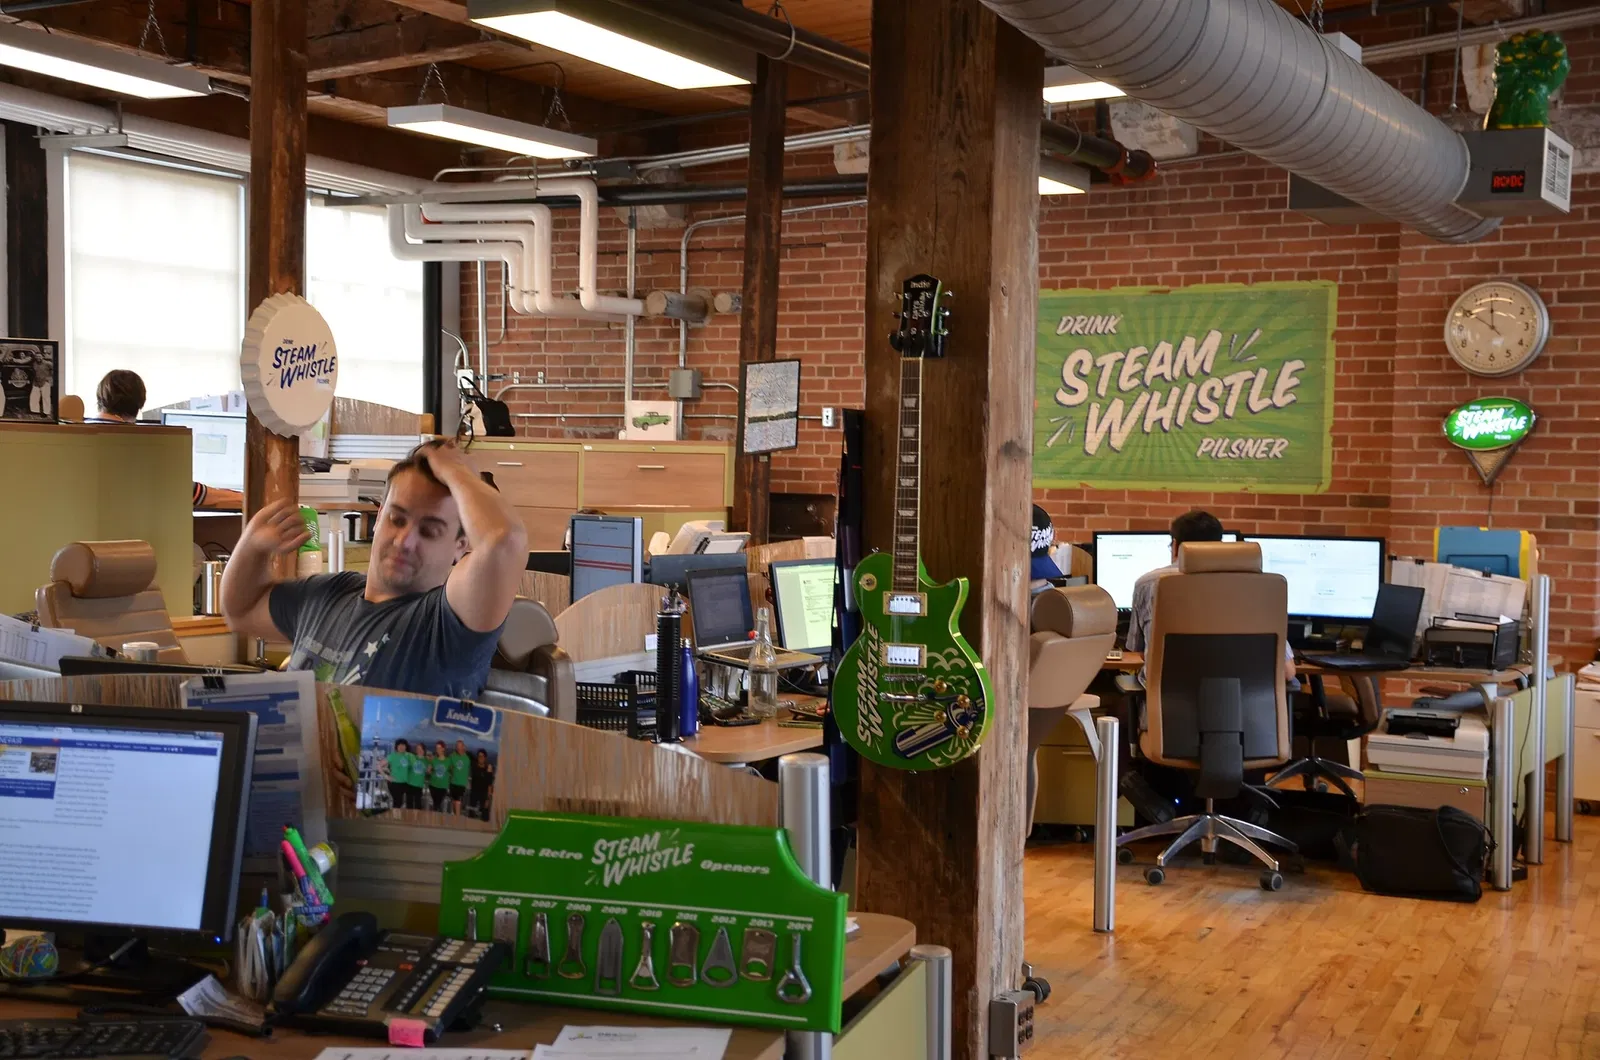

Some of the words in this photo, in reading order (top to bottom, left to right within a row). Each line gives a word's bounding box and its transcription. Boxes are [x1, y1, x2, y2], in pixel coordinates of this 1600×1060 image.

[1056, 315, 1122, 336] DRINK
[272, 343, 317, 369] STEAM
[280, 356, 336, 389] WHISTLE
[1055, 329, 1223, 408] STEAM
[1083, 359, 1306, 456] WHISTLE
[1196, 437, 1290, 460] PILSNER
[867, 621, 884, 737] WHISTLE
[857, 658, 872, 747] STEAM
[506, 845, 535, 856] The
[539, 848, 583, 860] Retro
[591, 831, 662, 865] STEAM
[603, 843, 695, 888] WHISTLE
[700, 859, 770, 875] Openers
[531, 900, 558, 909] 2007
[711, 915, 737, 924] 2012
